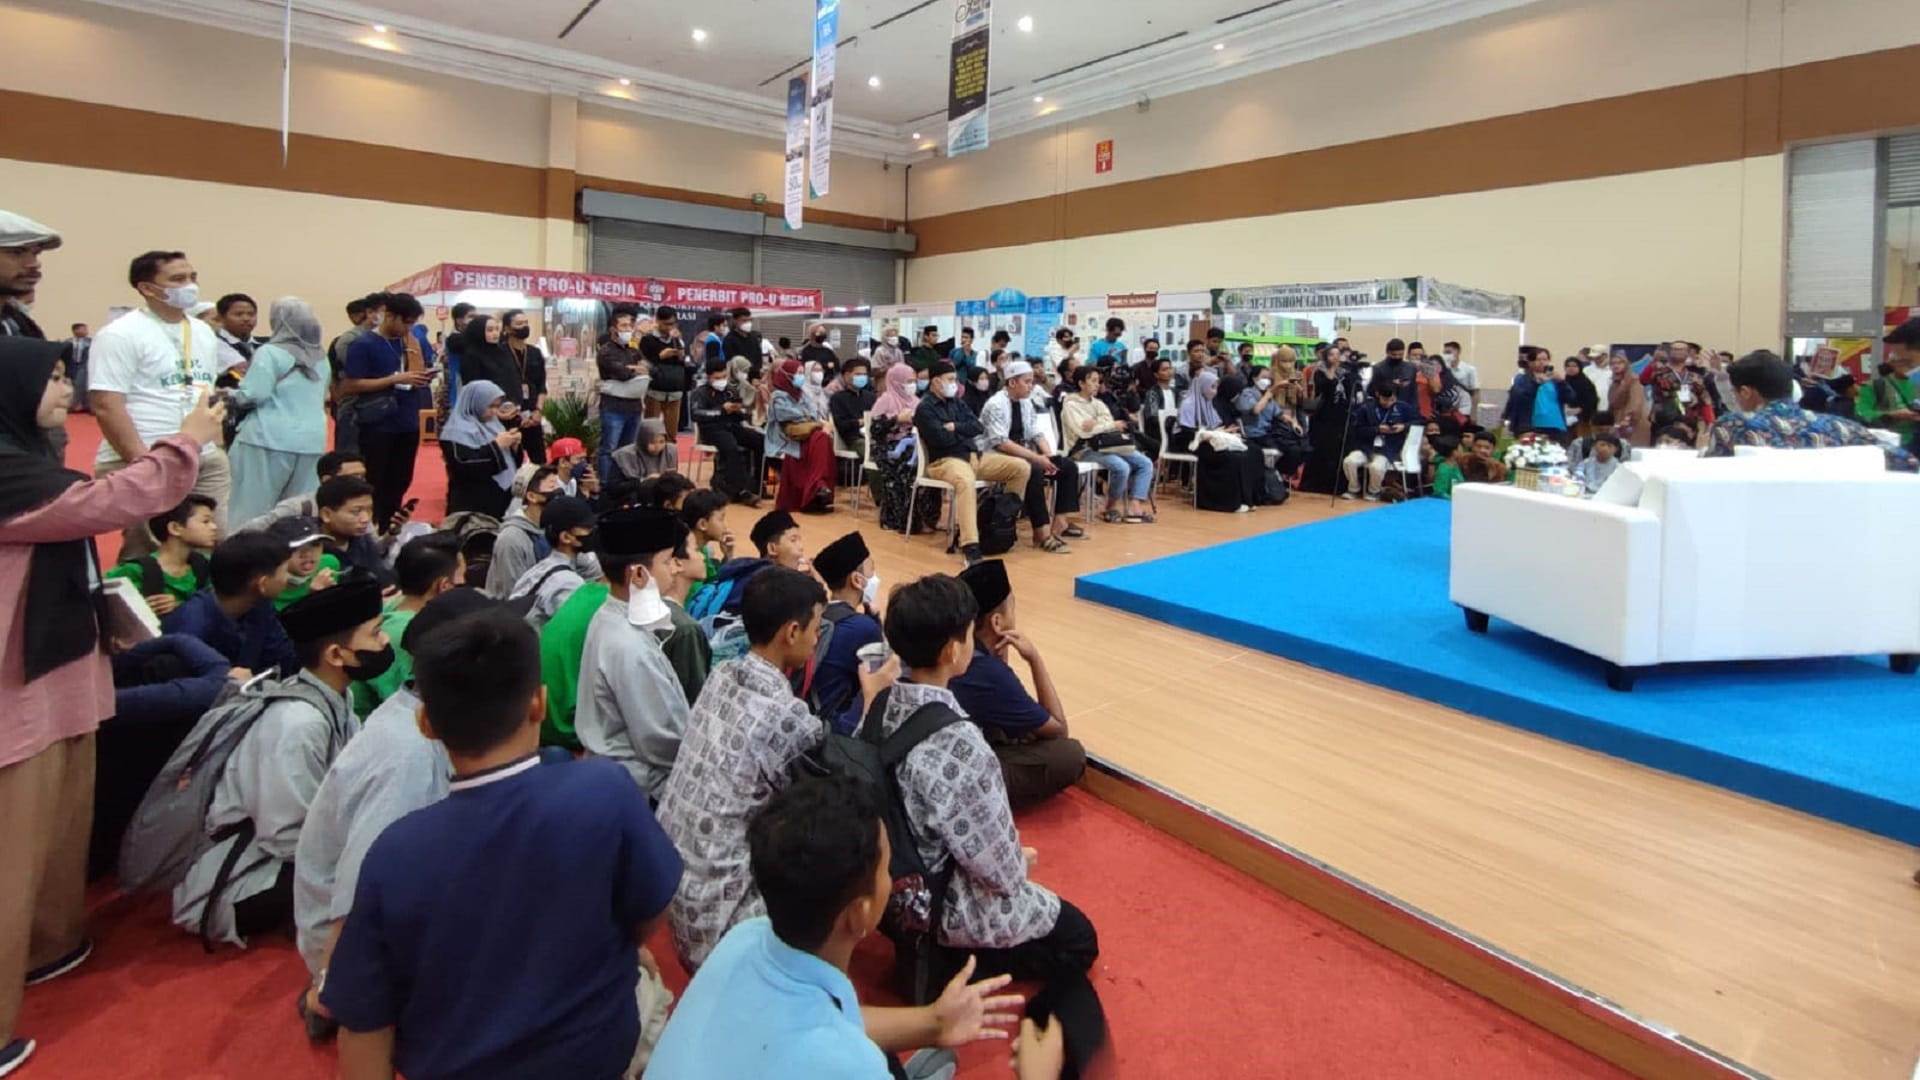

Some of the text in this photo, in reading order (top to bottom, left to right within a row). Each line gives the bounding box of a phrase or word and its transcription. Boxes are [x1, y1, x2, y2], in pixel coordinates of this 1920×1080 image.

[453, 271, 532, 290] PENERBIT
[538, 276, 585, 295] PRO-U
[591, 281, 635, 297] MEDIA
[677, 286, 737, 304] PENERBIT
[740, 290, 777, 307] PRO-U
[779, 293, 815, 308] MEDIA
